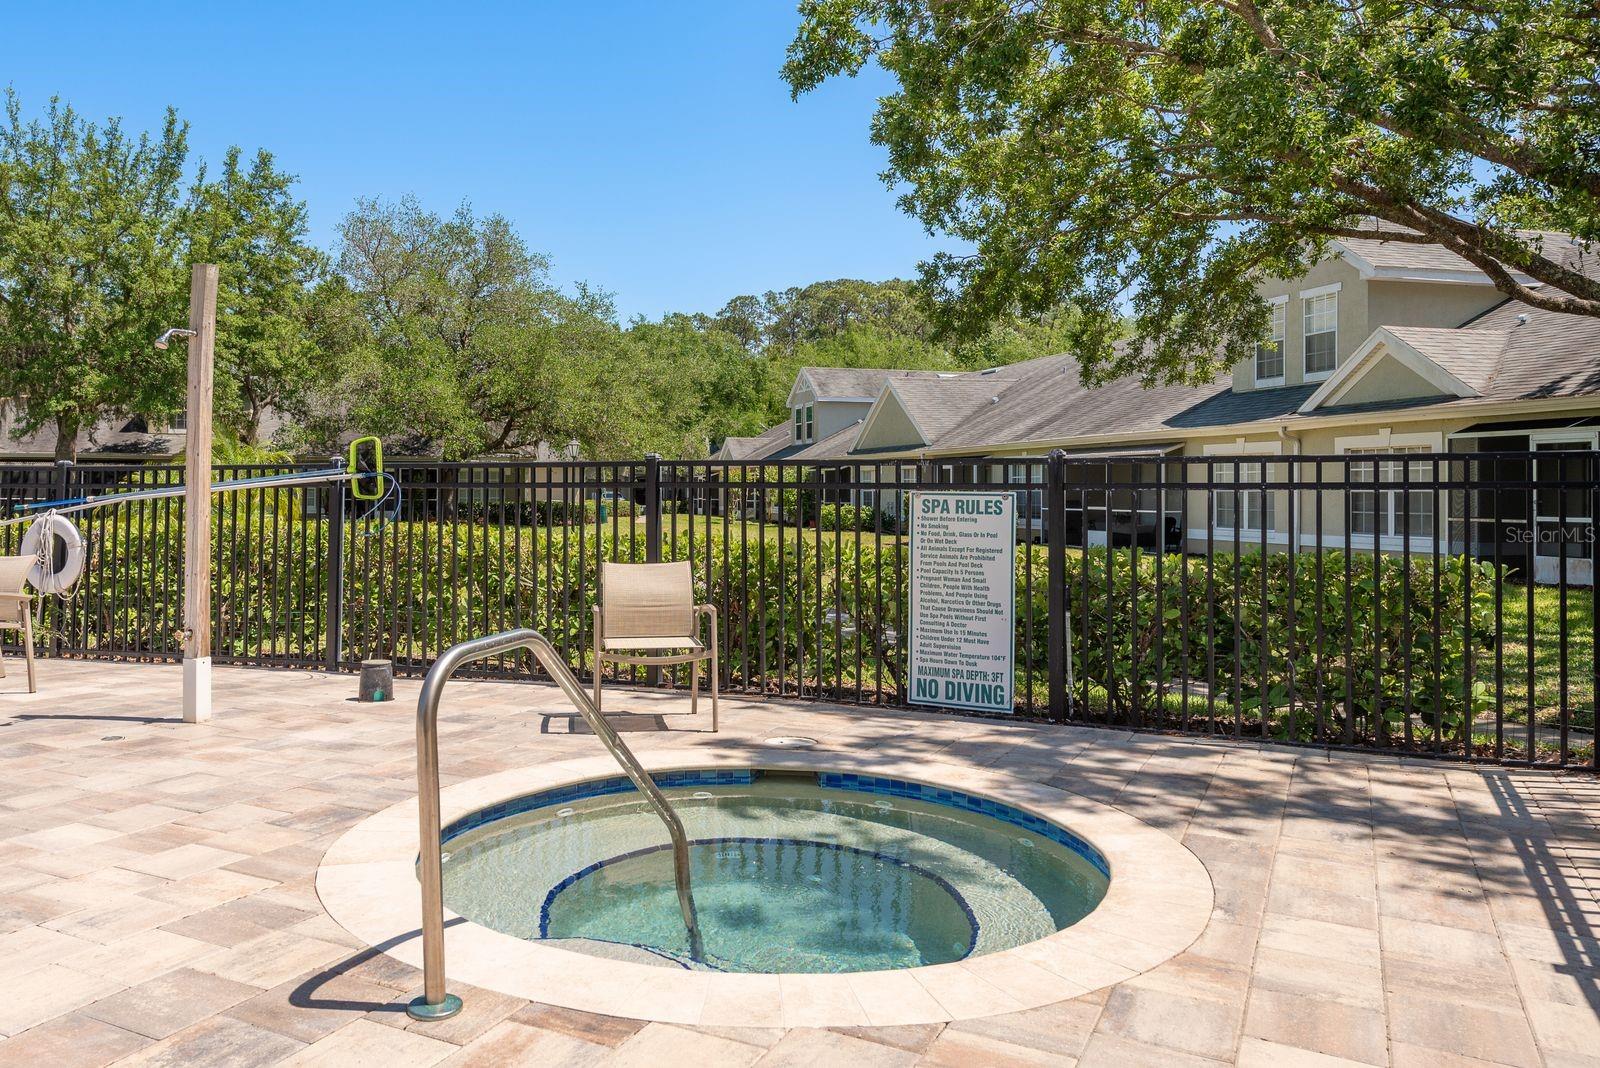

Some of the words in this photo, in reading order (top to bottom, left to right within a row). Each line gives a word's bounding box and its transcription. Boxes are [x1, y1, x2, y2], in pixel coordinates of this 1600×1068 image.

[922, 499, 950, 514] SPA
[956, 500, 1003, 515] RULES
[918, 666, 950, 678] MAXIMUM
[952, 669, 964, 679] SPA
[966, 670, 989, 681] DEPTH:
[991, 672, 1004, 682] 3FT
[917, 678, 938, 698] NO
[945, 681, 1004, 705] DIVING
